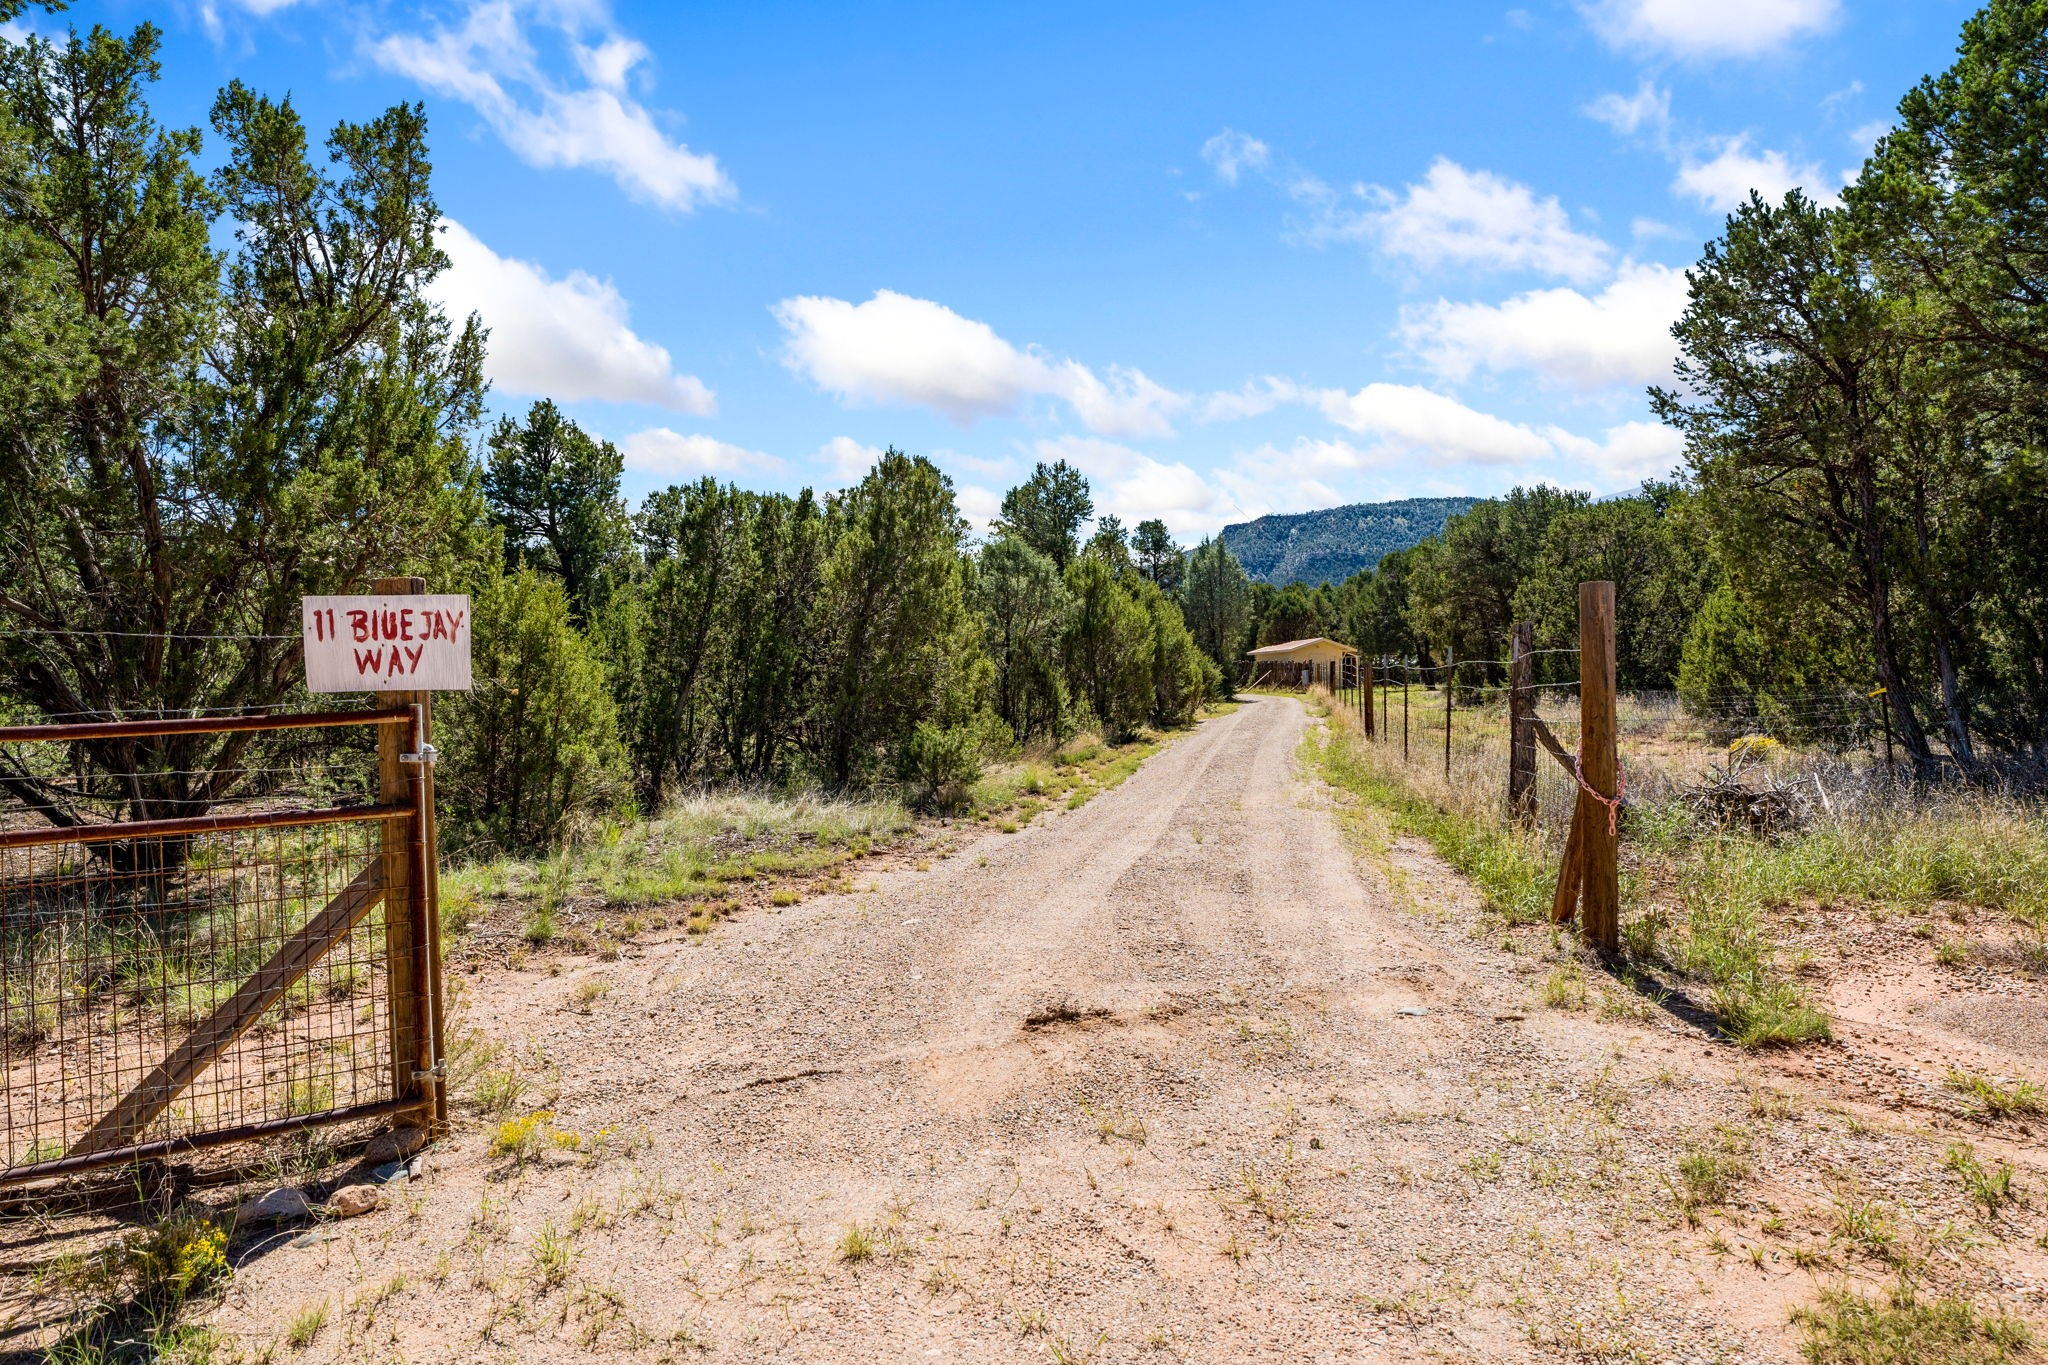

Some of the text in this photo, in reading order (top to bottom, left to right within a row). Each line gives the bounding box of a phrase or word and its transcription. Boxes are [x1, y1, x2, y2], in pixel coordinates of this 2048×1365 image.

[313, 608, 335, 642] 11
[419, 608, 464, 644] JAY
[354, 643, 424, 677] WAY
